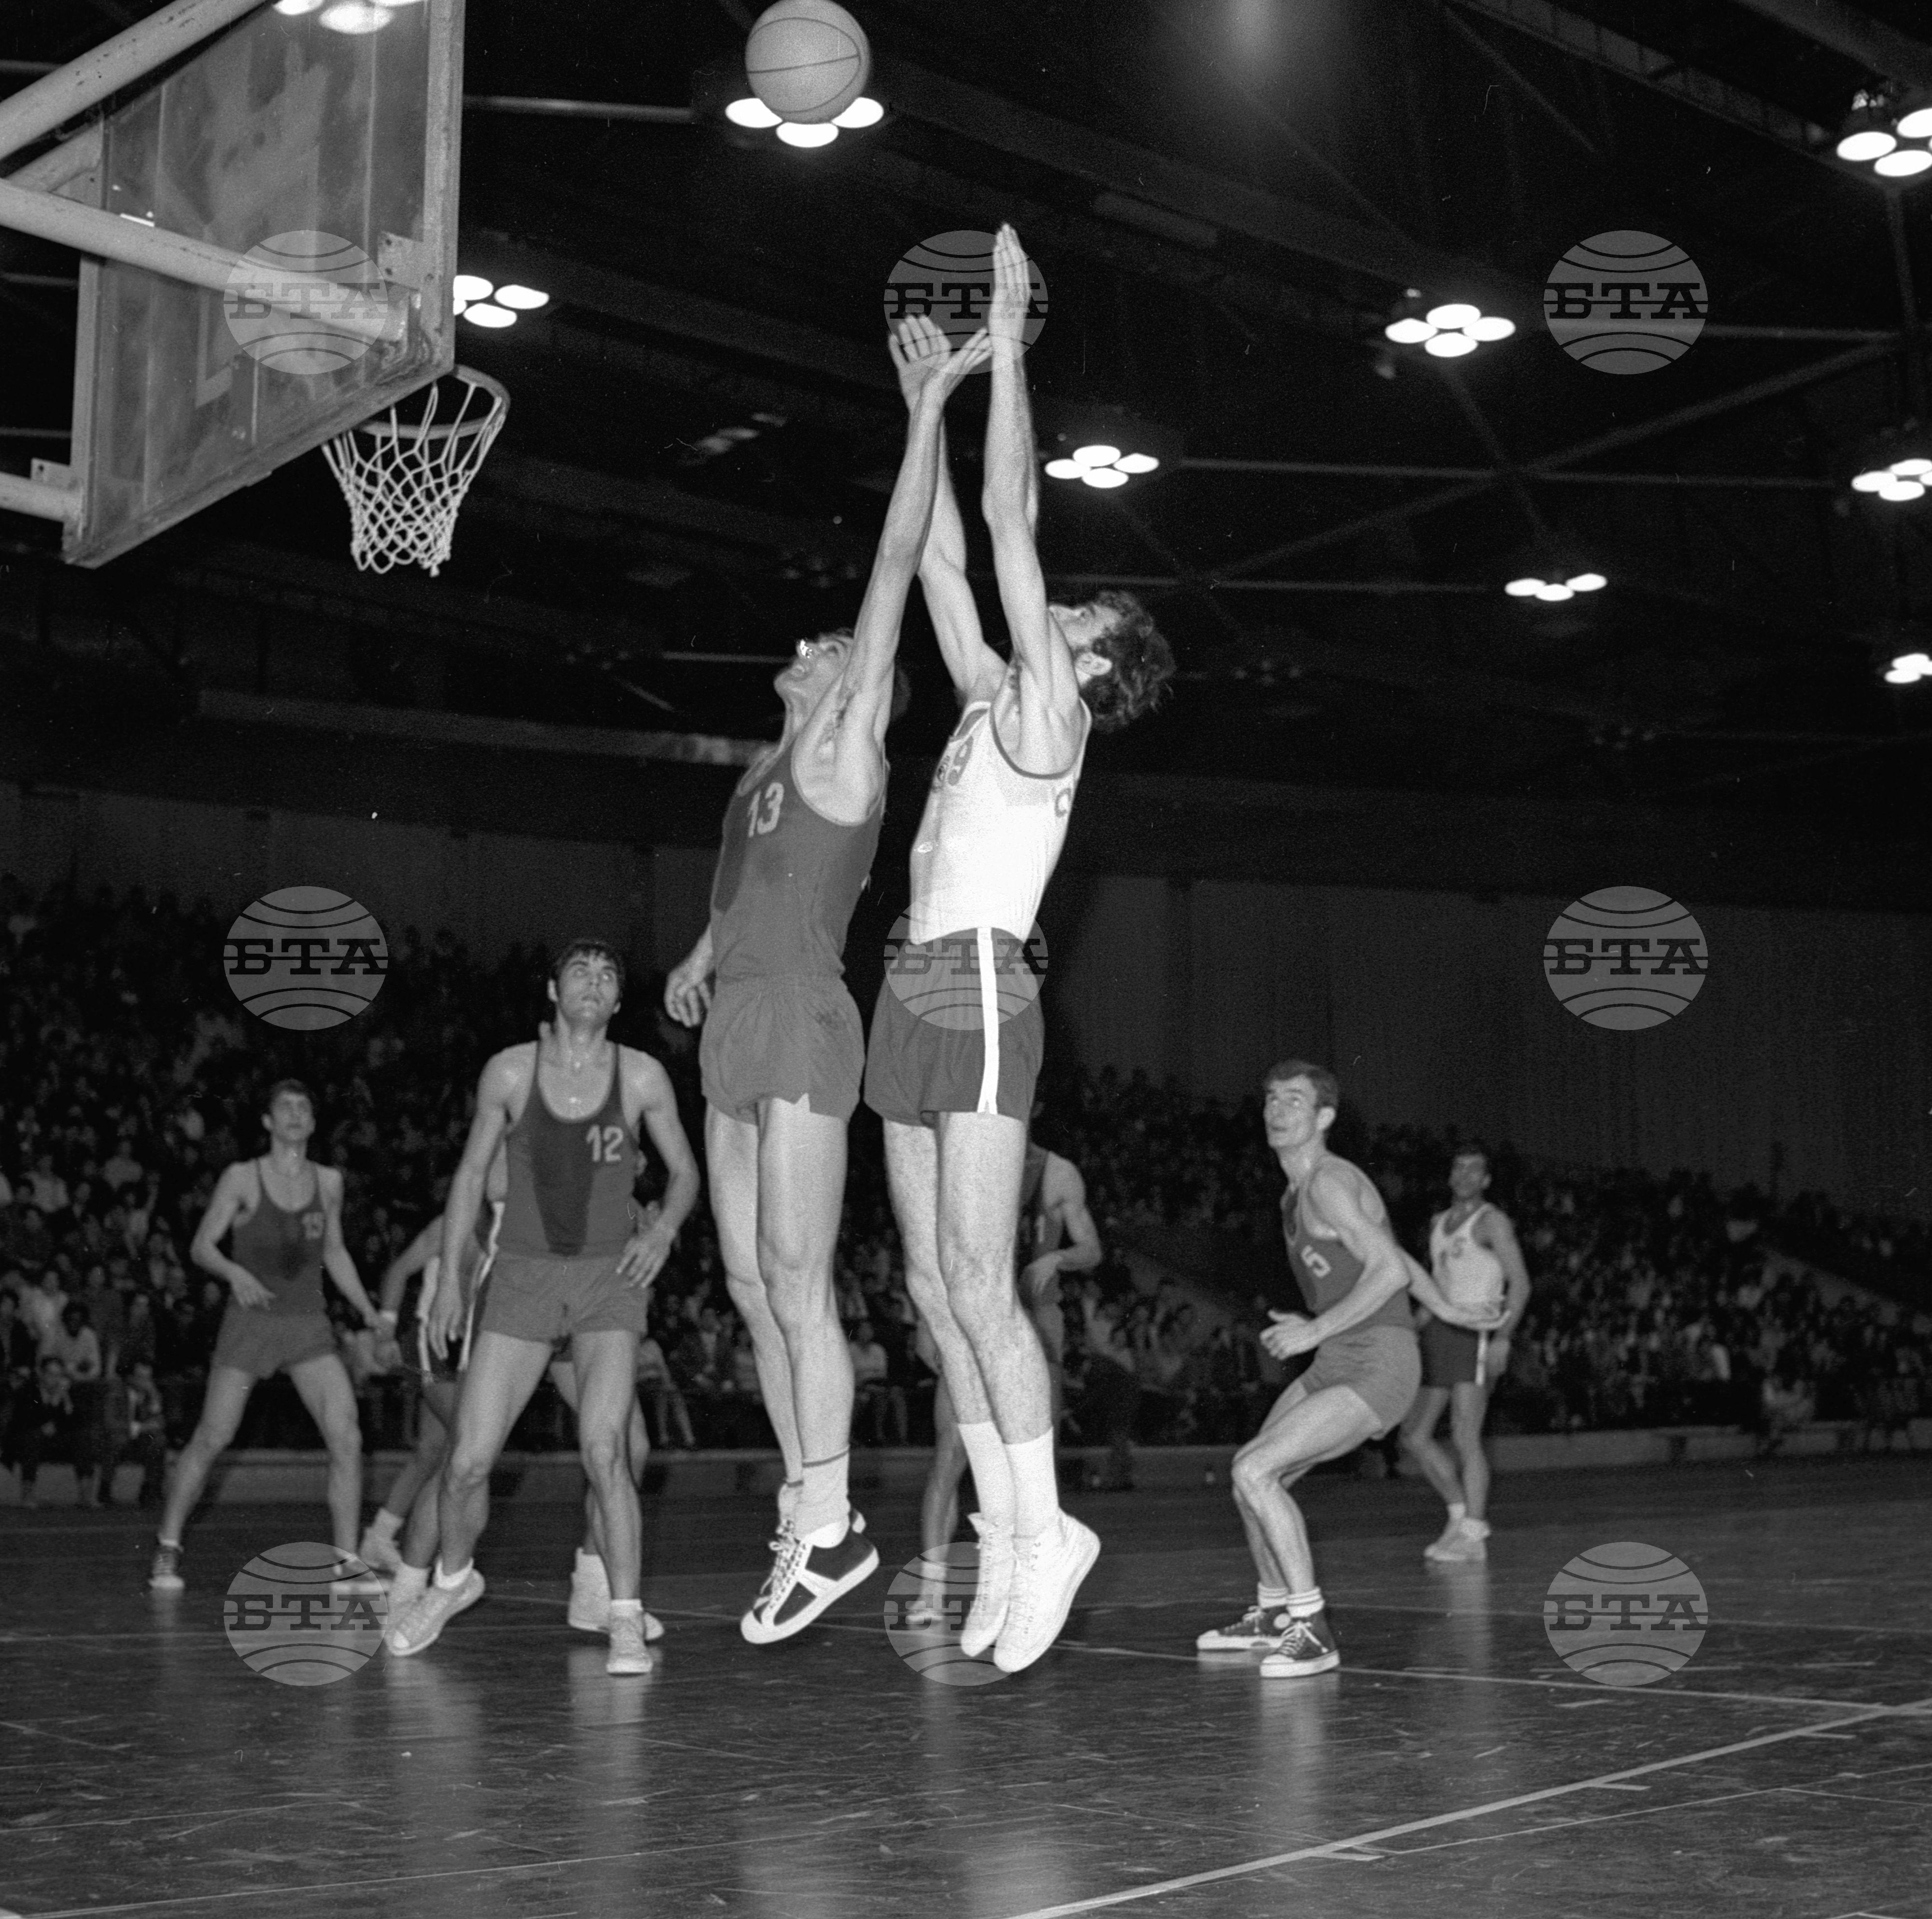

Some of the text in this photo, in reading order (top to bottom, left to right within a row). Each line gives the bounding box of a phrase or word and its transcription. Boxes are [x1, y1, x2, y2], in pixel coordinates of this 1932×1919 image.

[746, 781, 784, 838] 13
[586, 1124, 624, 1163] 12
[1301, 1244, 1331, 1278] 5
